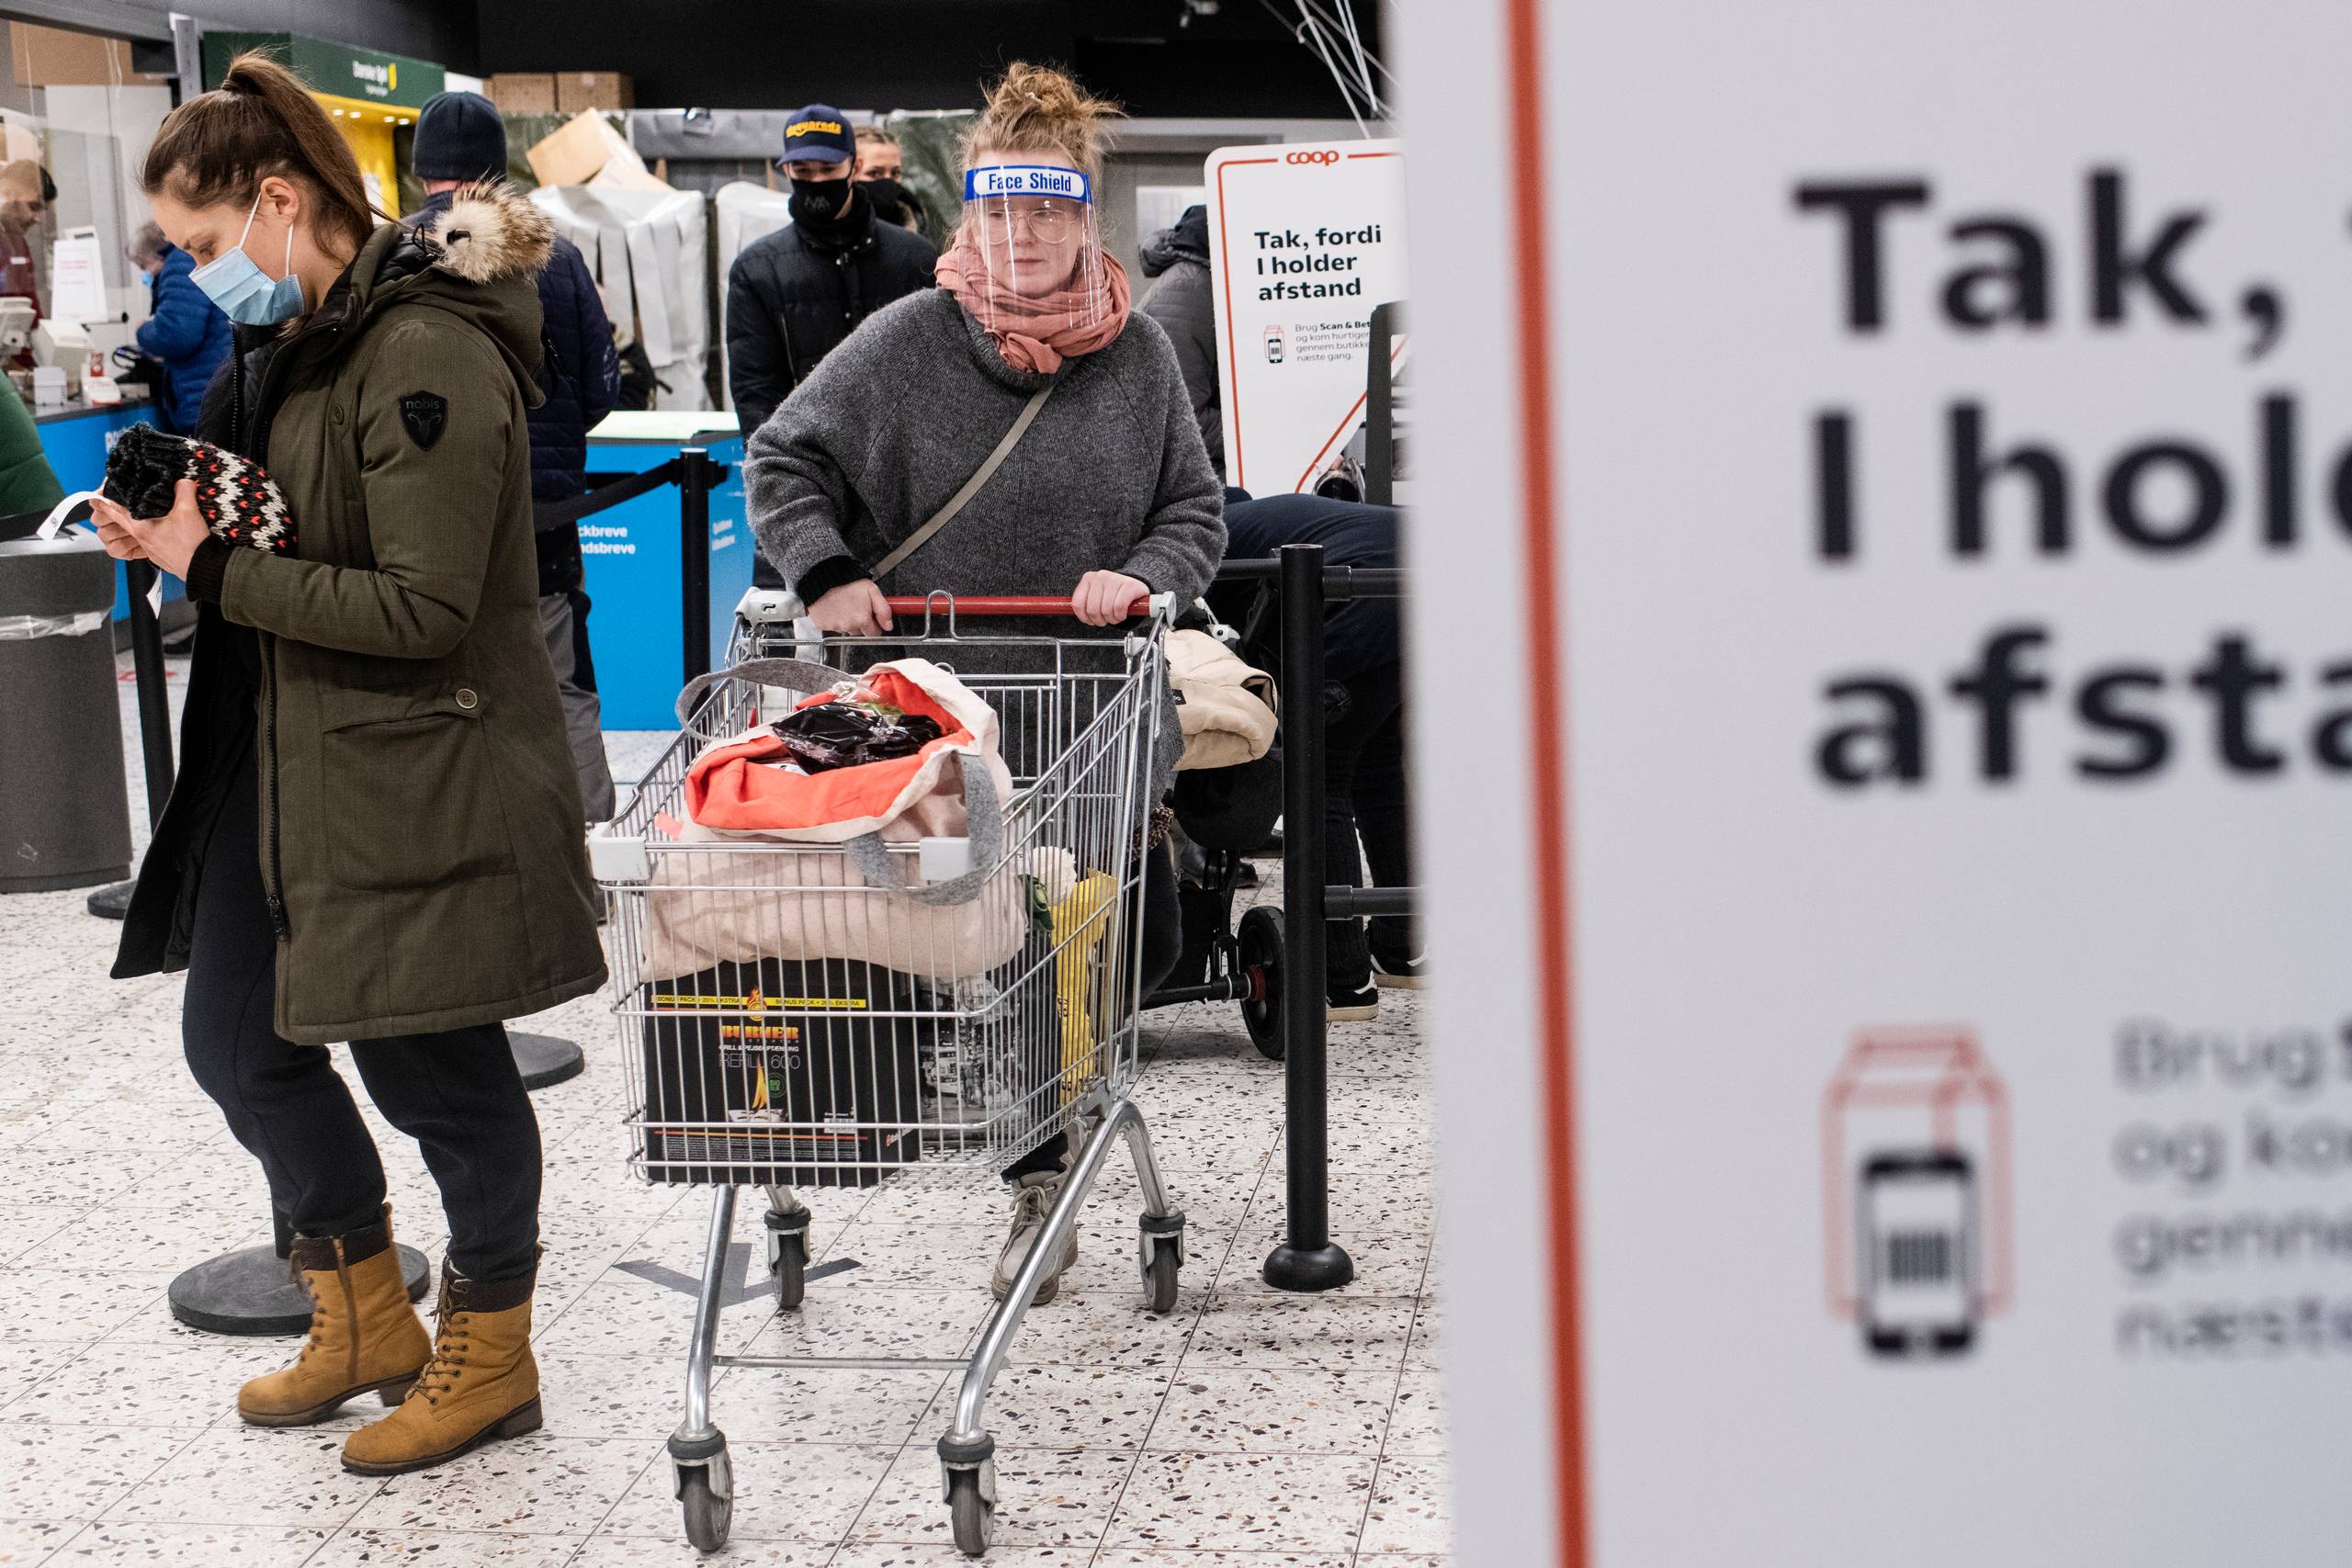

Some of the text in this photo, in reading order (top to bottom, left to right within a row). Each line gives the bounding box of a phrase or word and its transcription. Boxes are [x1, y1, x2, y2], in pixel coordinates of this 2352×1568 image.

[1286, 150, 1340, 166] coop
[989, 173, 1071, 192] Face Shield
[1254, 224, 1381, 251] Tak, fordi
[1258, 254, 1357, 275] I holder
[1792, 165, 2284, 364] Tak,
[1259, 277, 1362, 301] afstand
[1295, 323, 1317, 333] Brug
[1320, 322, 1342, 331] Scan
[1332, 332, 1369, 340] hurtiger
[1296, 344, 1334, 353] gennem
[1328, 352, 1352, 361] gang.
[406, 399, 440, 410] nobis
[1812, 409, 1854, 562] I
[579, 525, 628, 537] ckbreve
[2245, 1104, 2352, 1180] ko
